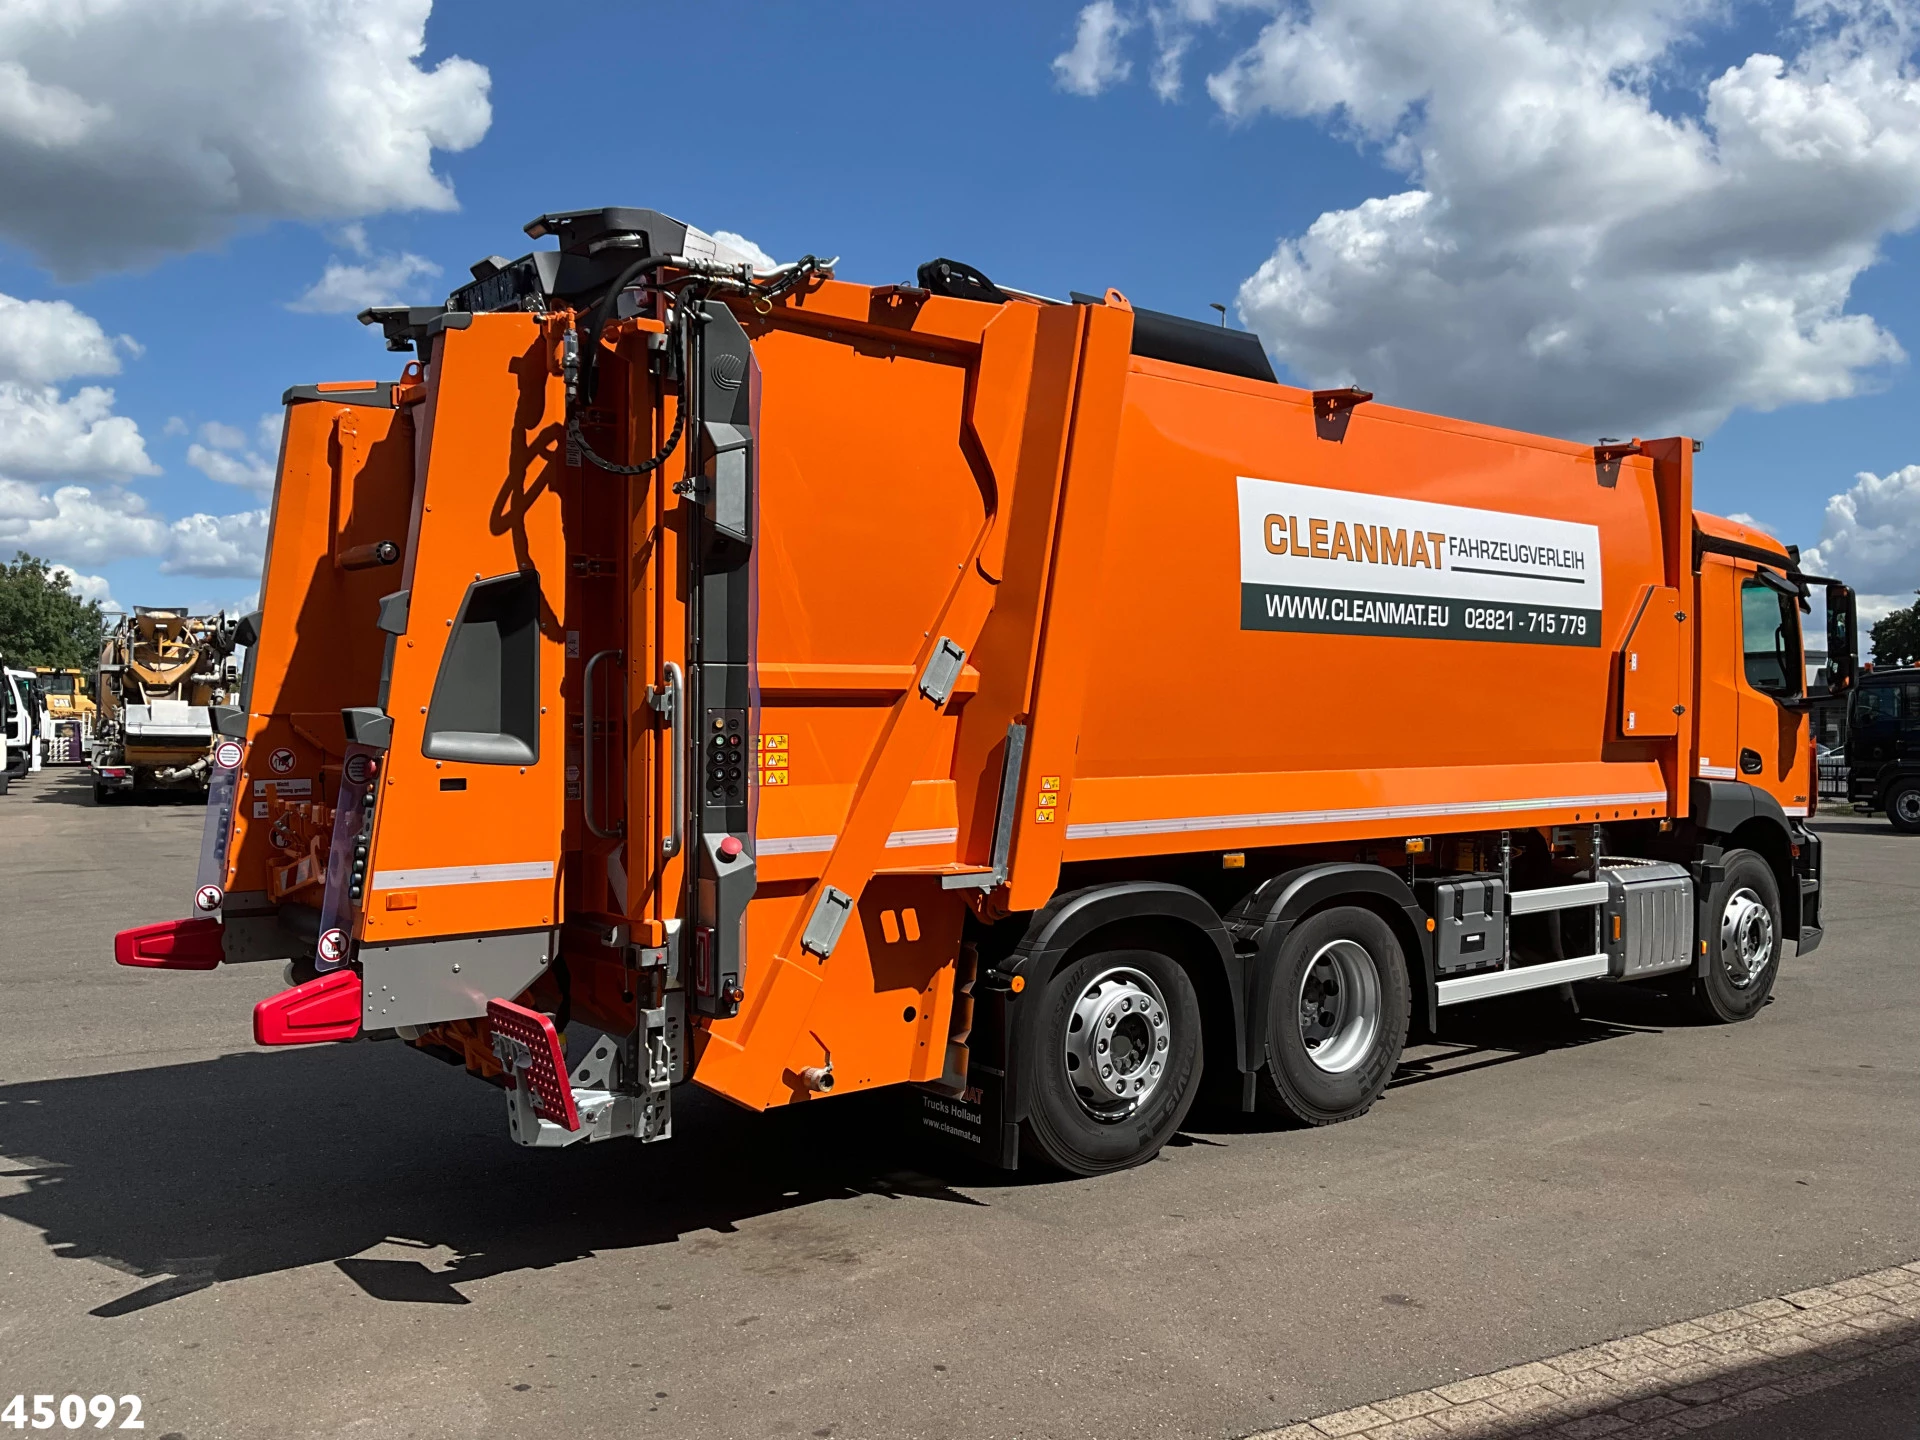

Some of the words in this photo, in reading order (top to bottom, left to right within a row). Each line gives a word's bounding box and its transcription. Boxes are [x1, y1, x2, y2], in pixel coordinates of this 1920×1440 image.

[1263, 513, 1446, 570] CLEANMAT
[1448, 536, 1586, 571] FAHRZEUGVERLEIH
[1264, 593, 1449, 628] WWW.CLEANMAT.EU
[1464, 607, 1514, 631] 02821
[1527, 611, 1556, 635] 715
[1560, 614, 1587, 636] 779
[922, 1095, 950, 1115] Trucks
[951, 1104, 982, 1125] Holland
[922, 1116, 981, 1144] www.cleanmat.eu
